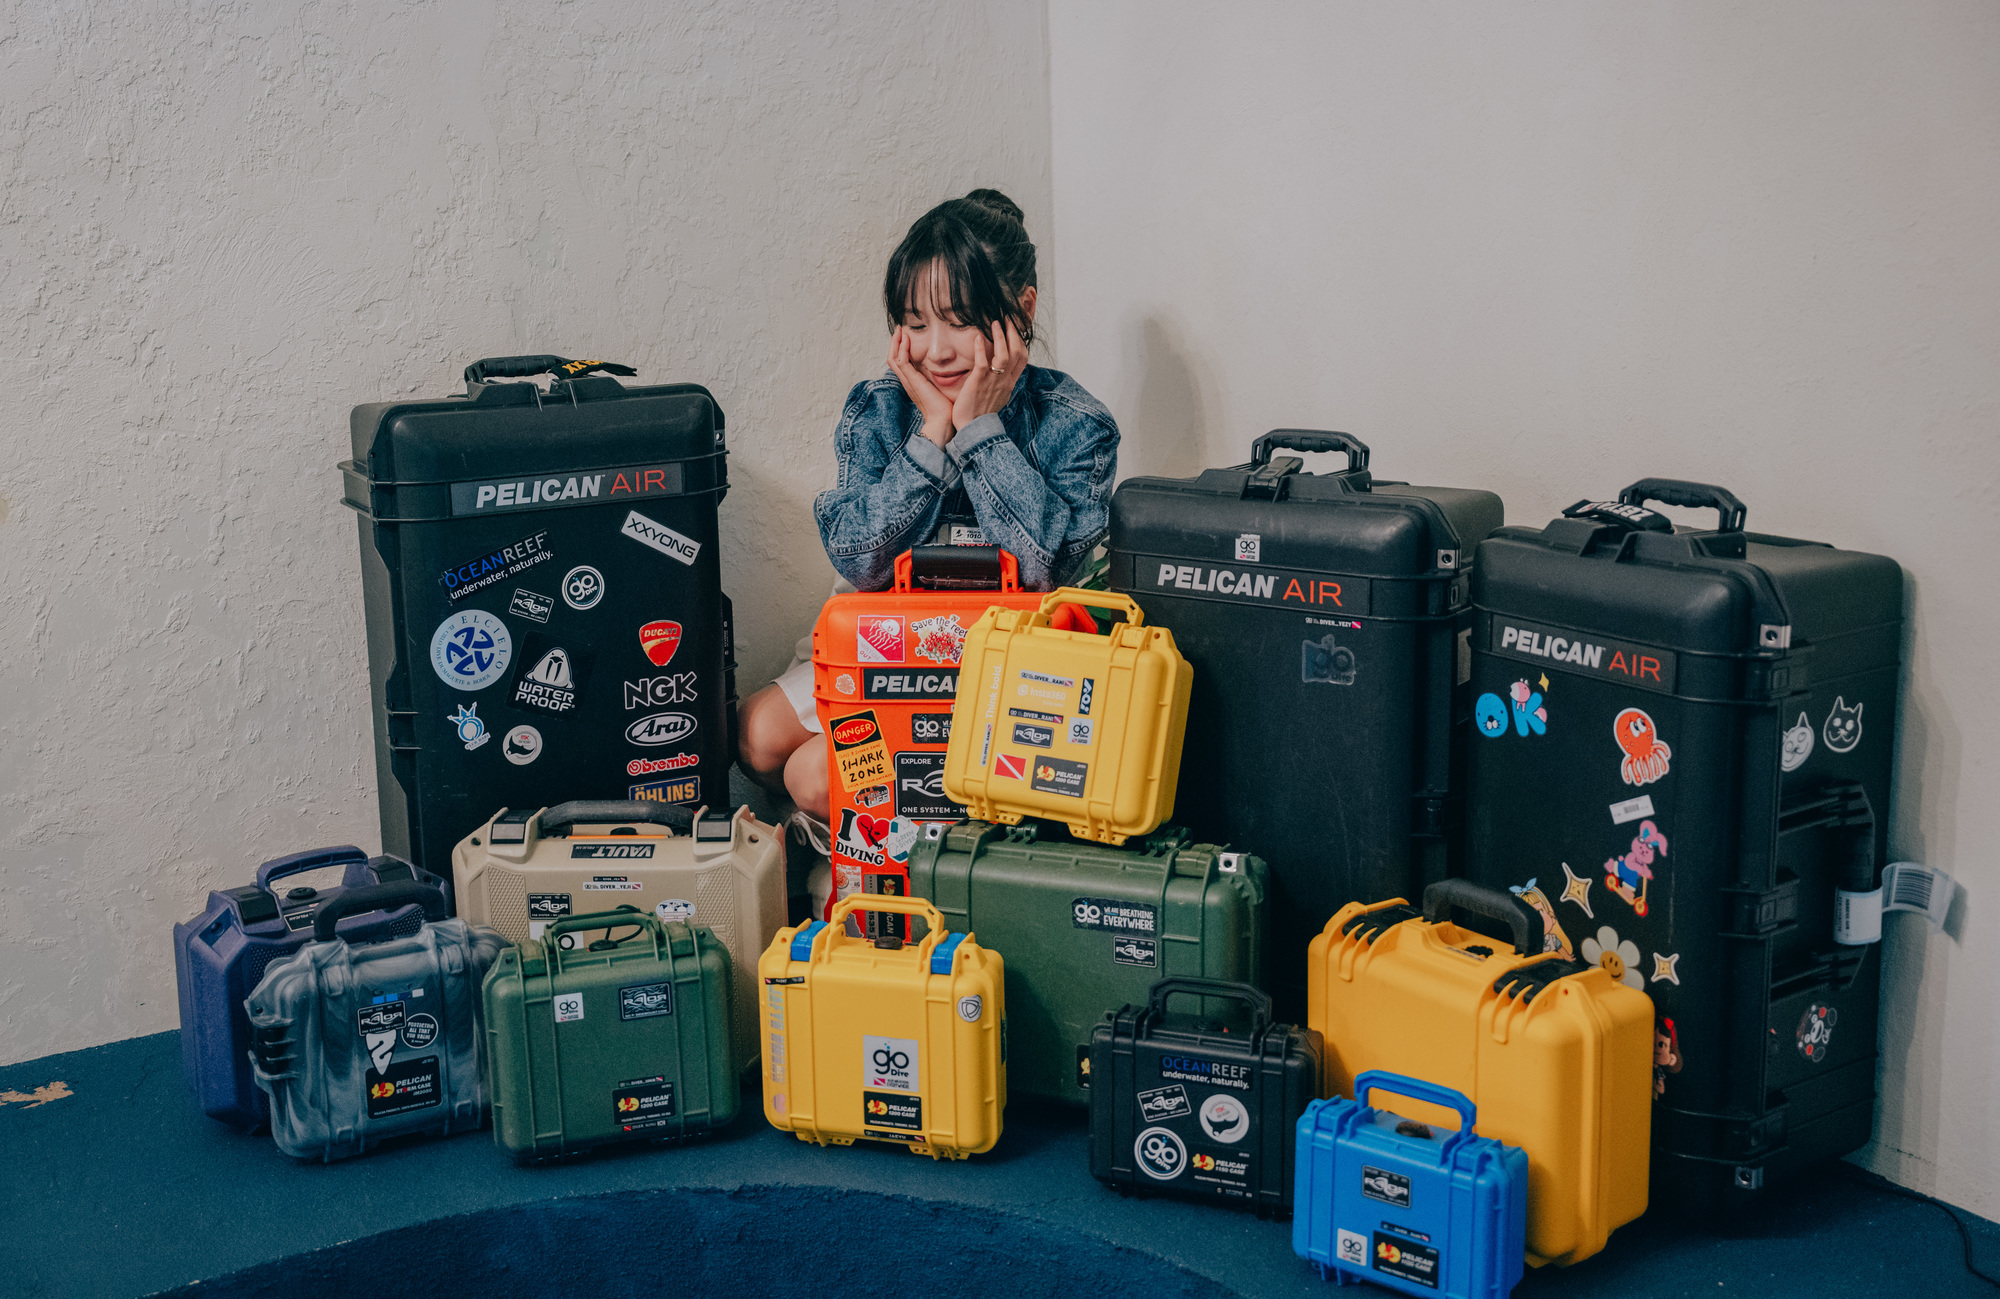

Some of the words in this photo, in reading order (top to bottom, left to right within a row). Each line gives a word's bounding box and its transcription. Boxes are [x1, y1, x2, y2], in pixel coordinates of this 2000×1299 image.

[476, 475, 601, 508] PELICAN
[610, 469, 666, 494] AIR
[627, 518, 696, 558] XXYONG
[1240, 541, 1256, 553] go
[451, 568, 508, 600] underwater,
[509, 550, 553, 579] naturally.
[570, 575, 594, 600] go
[1157, 564, 1275, 598] PELICAN
[1283, 578, 1342, 607] AIR
[645, 628, 677, 638] DUCATI
[912, 619, 933, 632] Save
[936, 617, 950, 627] the
[860, 650, 871, 661] OUT
[1501, 626, 1602, 668] PELICAN
[1609, 650, 1661, 682] AIR
[871, 676, 959, 693] PELICA
[990, 664, 1002, 690] bold.
[519, 681, 575, 703] WATER
[624, 672, 698, 710] NGK
[1031, 688, 1066, 700] Insta360
[515, 692, 572, 712] PROOF
[985, 692, 997, 719] Think
[634, 717, 688, 740] Arai
[836, 724, 872, 740] DANGER
[915, 721, 939, 737] go
[1073, 724, 1090, 737] go
[641, 753, 699, 773] brembo
[843, 750, 884, 772] SHARK
[849, 764, 884, 782] ZONE
[1056, 771, 1082, 780] PELICAN
[635, 782, 696, 803] ÖHLINS
[838, 809, 857, 841] I
[592, 846, 651, 857] VAULT
[836, 841, 884, 865] DIVING
[1075, 904, 1100, 923] go
[1120, 908, 1153, 919] BREATHING
[1104, 916, 1154, 931] EVERYWHERE
[559, 1001, 578, 1015] go
[873, 1049, 909, 1075] go
[396, 1074, 432, 1087] PELICAN
[891, 1069, 909, 1077] Dive
[1163, 1071, 1210, 1084] underwater,
[1212, 1077, 1249, 1090] naturally.
[396, 1085, 417, 1094] STORM
[641, 1095, 669, 1103] PELICAN
[889, 1105, 916, 1113] PELICAN
[1144, 1138, 1178, 1164] go
[1155, 1158, 1171, 1170] Dive
[1216, 1160, 1246, 1170] PELICAN
[1343, 1238, 1362, 1253] go
[1402, 1252, 1434, 1267] PELICAN
